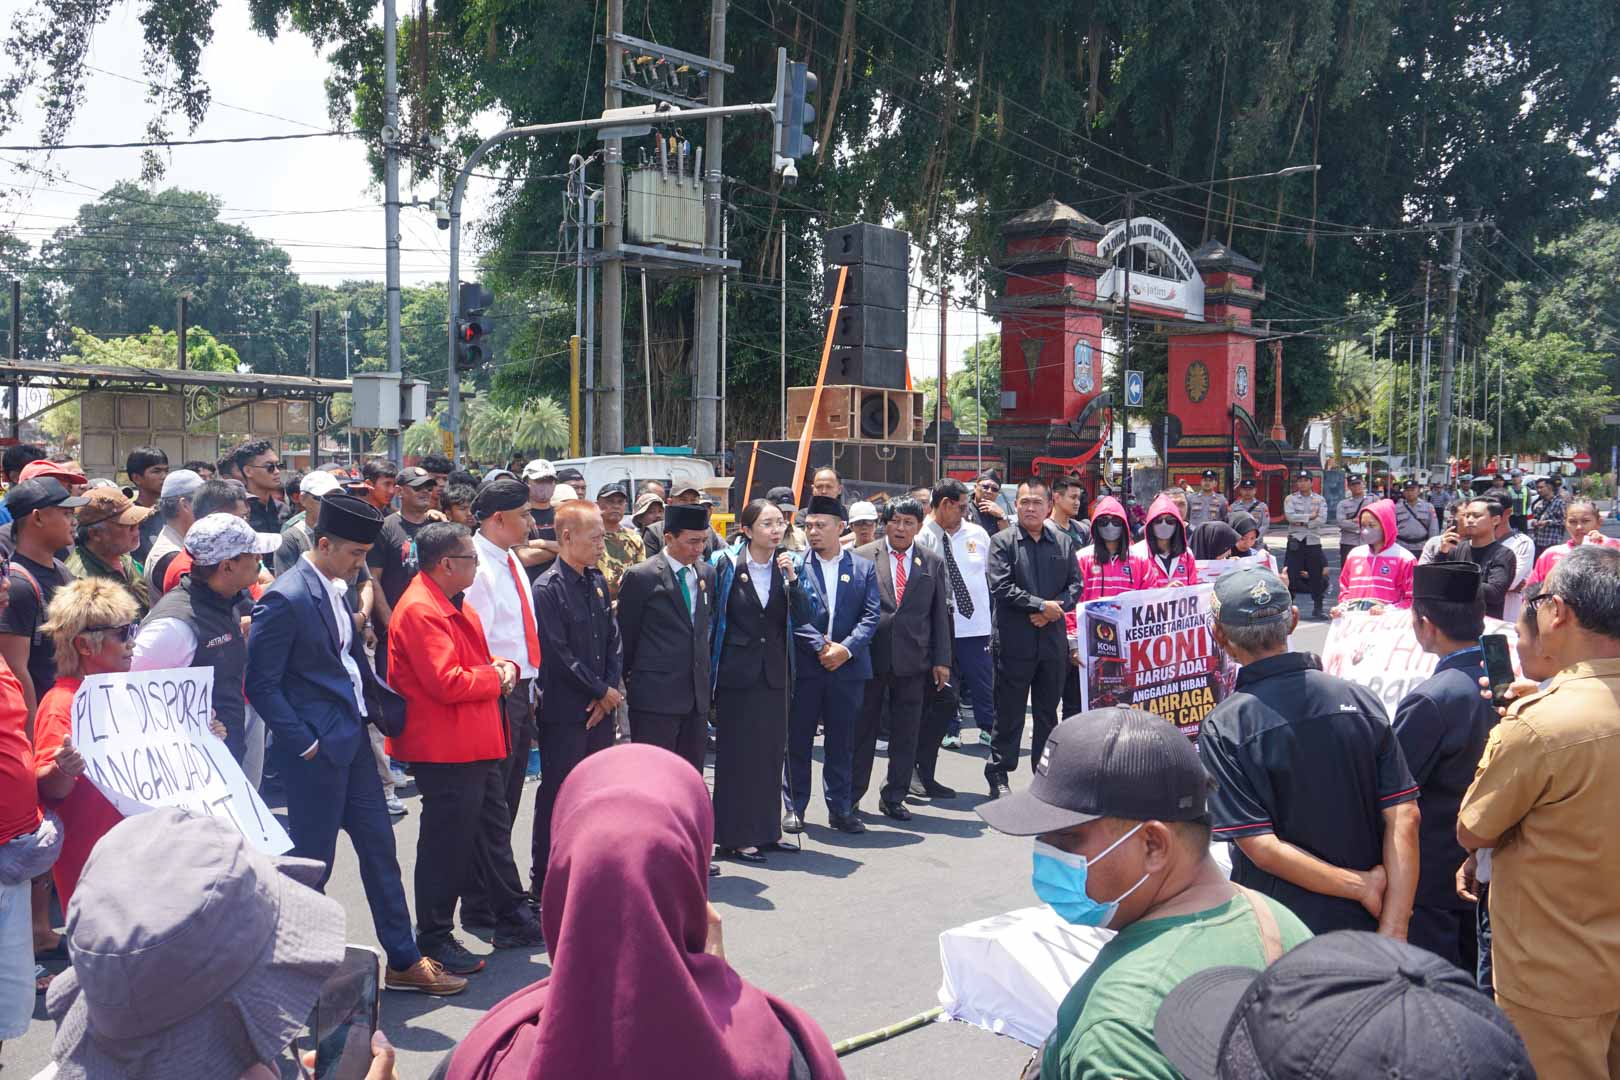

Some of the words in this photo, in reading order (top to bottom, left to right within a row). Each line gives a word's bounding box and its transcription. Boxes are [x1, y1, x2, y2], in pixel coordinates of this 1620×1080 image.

[1154, 227, 1170, 250] KOTA
[1172, 243, 1194, 280] BLITAR
[1125, 613, 1206, 641] KESEKRETARIATAN
[1132, 595, 1199, 627] KANTOR
[1129, 626, 1207, 672] KONI
[1135, 665, 1176, 687] HARUS
[1178, 657, 1208, 677] ADA!
[1132, 681, 1179, 704] ANGGARAN
[1180, 677, 1208, 692] HIBAH
[76, 685, 120, 746] PLT
[126, 680, 212, 738] DISPORA
